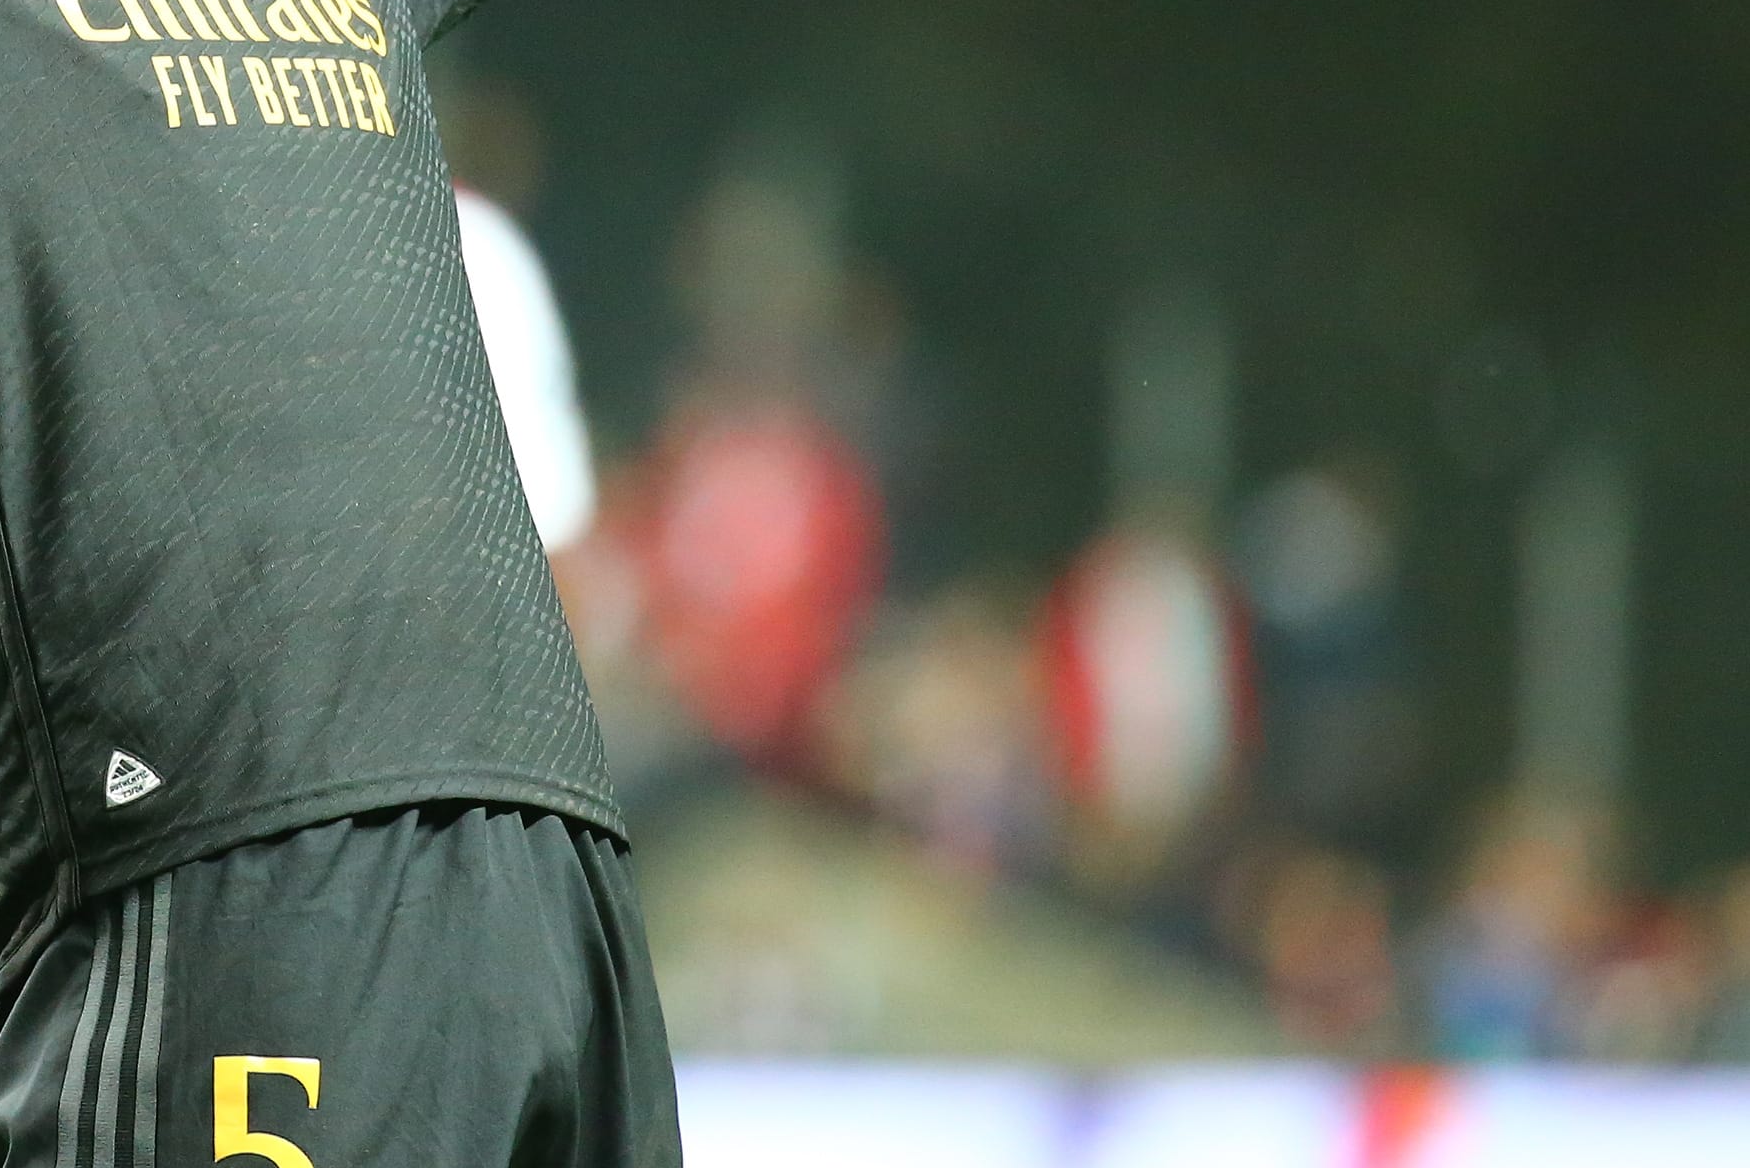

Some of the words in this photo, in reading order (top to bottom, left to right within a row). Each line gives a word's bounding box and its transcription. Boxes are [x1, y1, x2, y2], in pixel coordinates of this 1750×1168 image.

[151, 55, 237, 128] FLY
[242, 56, 396, 137] BETTER
[213, 1054, 321, 1168] 5
